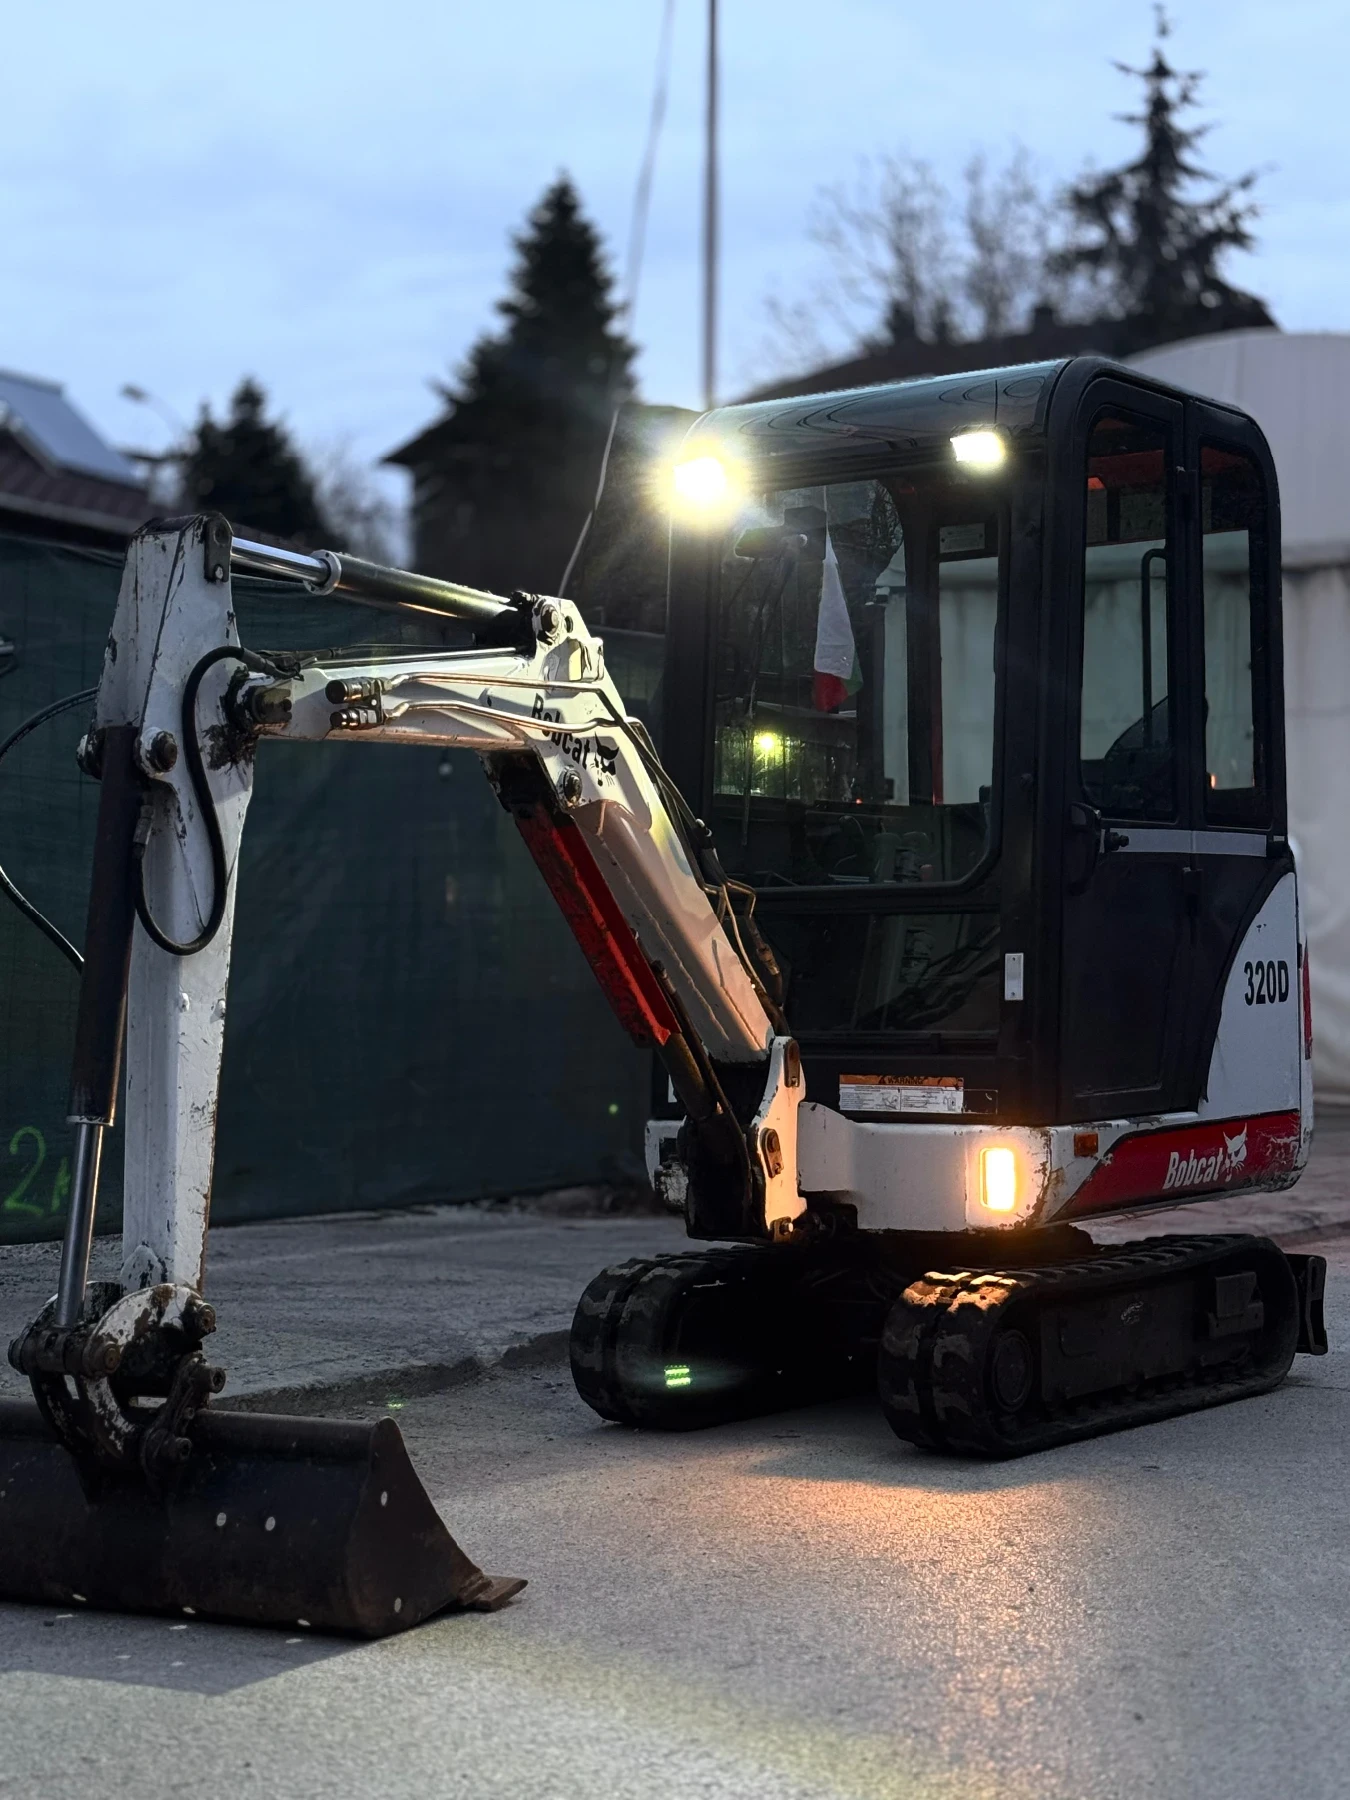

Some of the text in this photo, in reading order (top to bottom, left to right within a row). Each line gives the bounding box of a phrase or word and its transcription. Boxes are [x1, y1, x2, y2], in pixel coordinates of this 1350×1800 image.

[531, 692, 591, 770] Bobcat
[1244, 960, 1289, 1006] 320D
[887, 1075, 925, 1085] WARNING
[1163, 1148, 1223, 1190] Bobcat
